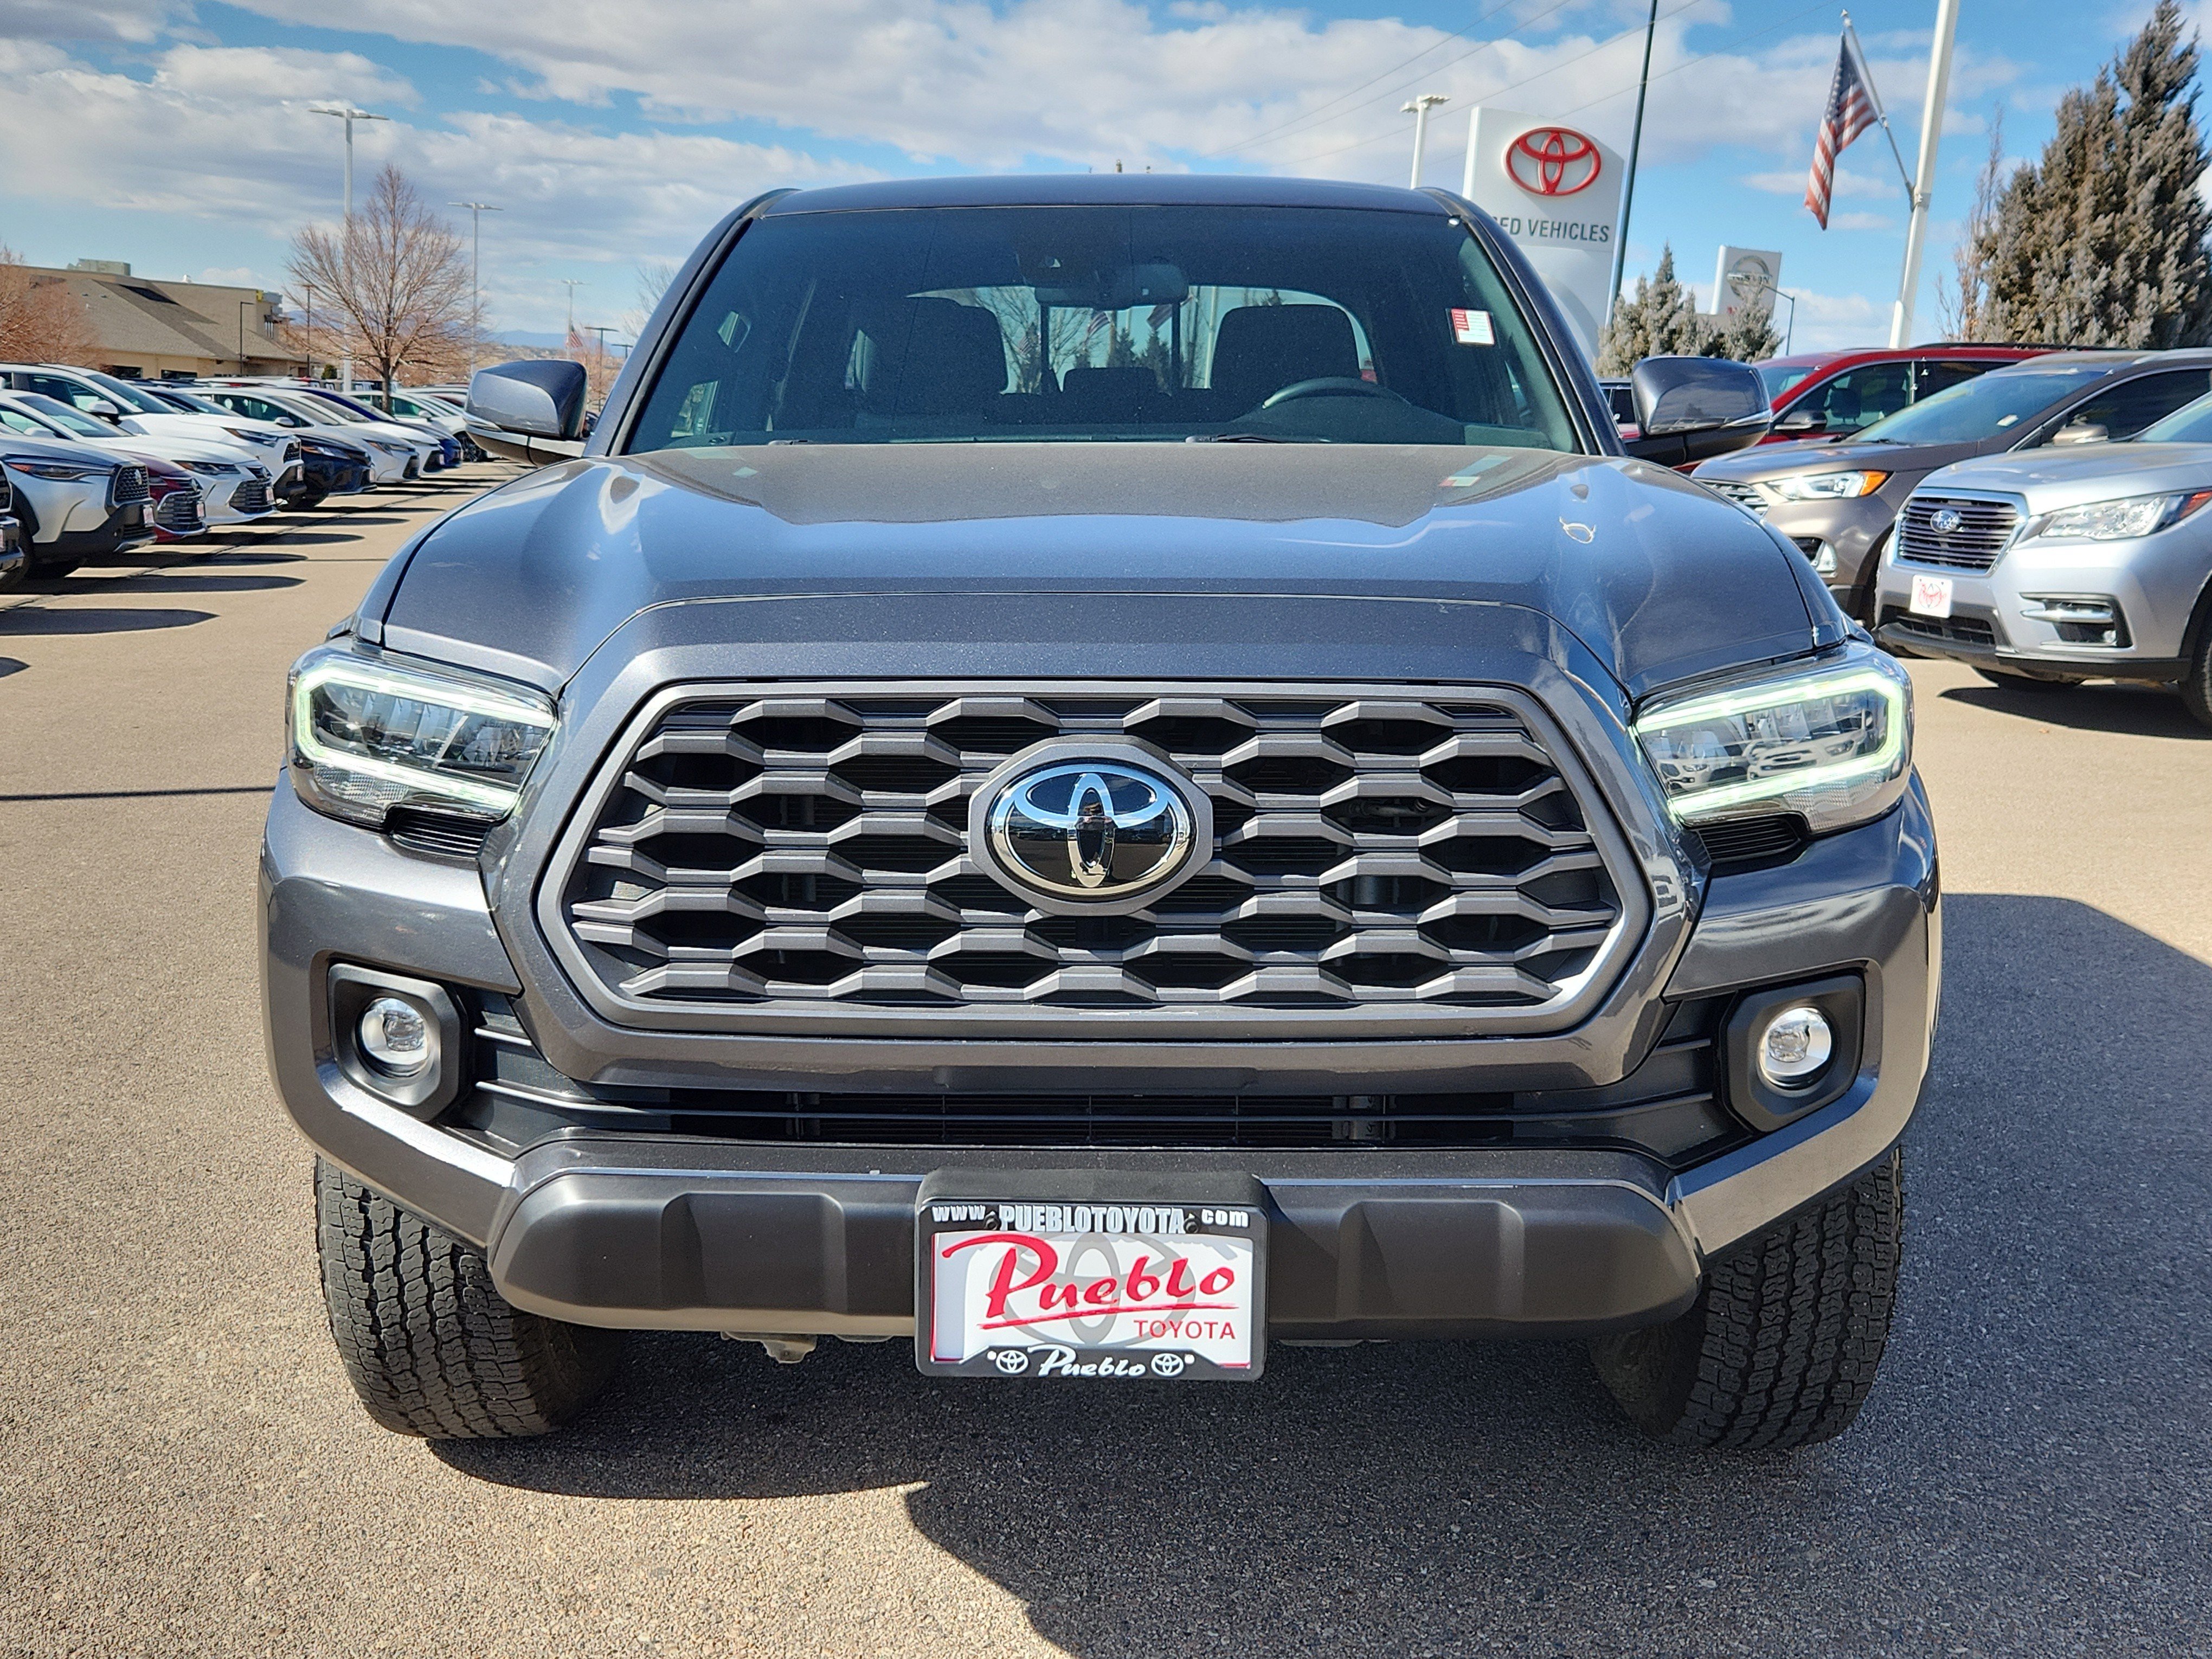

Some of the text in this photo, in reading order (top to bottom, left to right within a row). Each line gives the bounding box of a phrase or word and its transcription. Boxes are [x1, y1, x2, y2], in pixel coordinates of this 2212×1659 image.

[1493, 216, 1610, 242] ED VEHICLES
[942, 1233, 1235, 1319] Pueblo
[1133, 1319, 1236, 1340] TOYOTA
[1027, 1343, 1146, 1377] Pueblo
